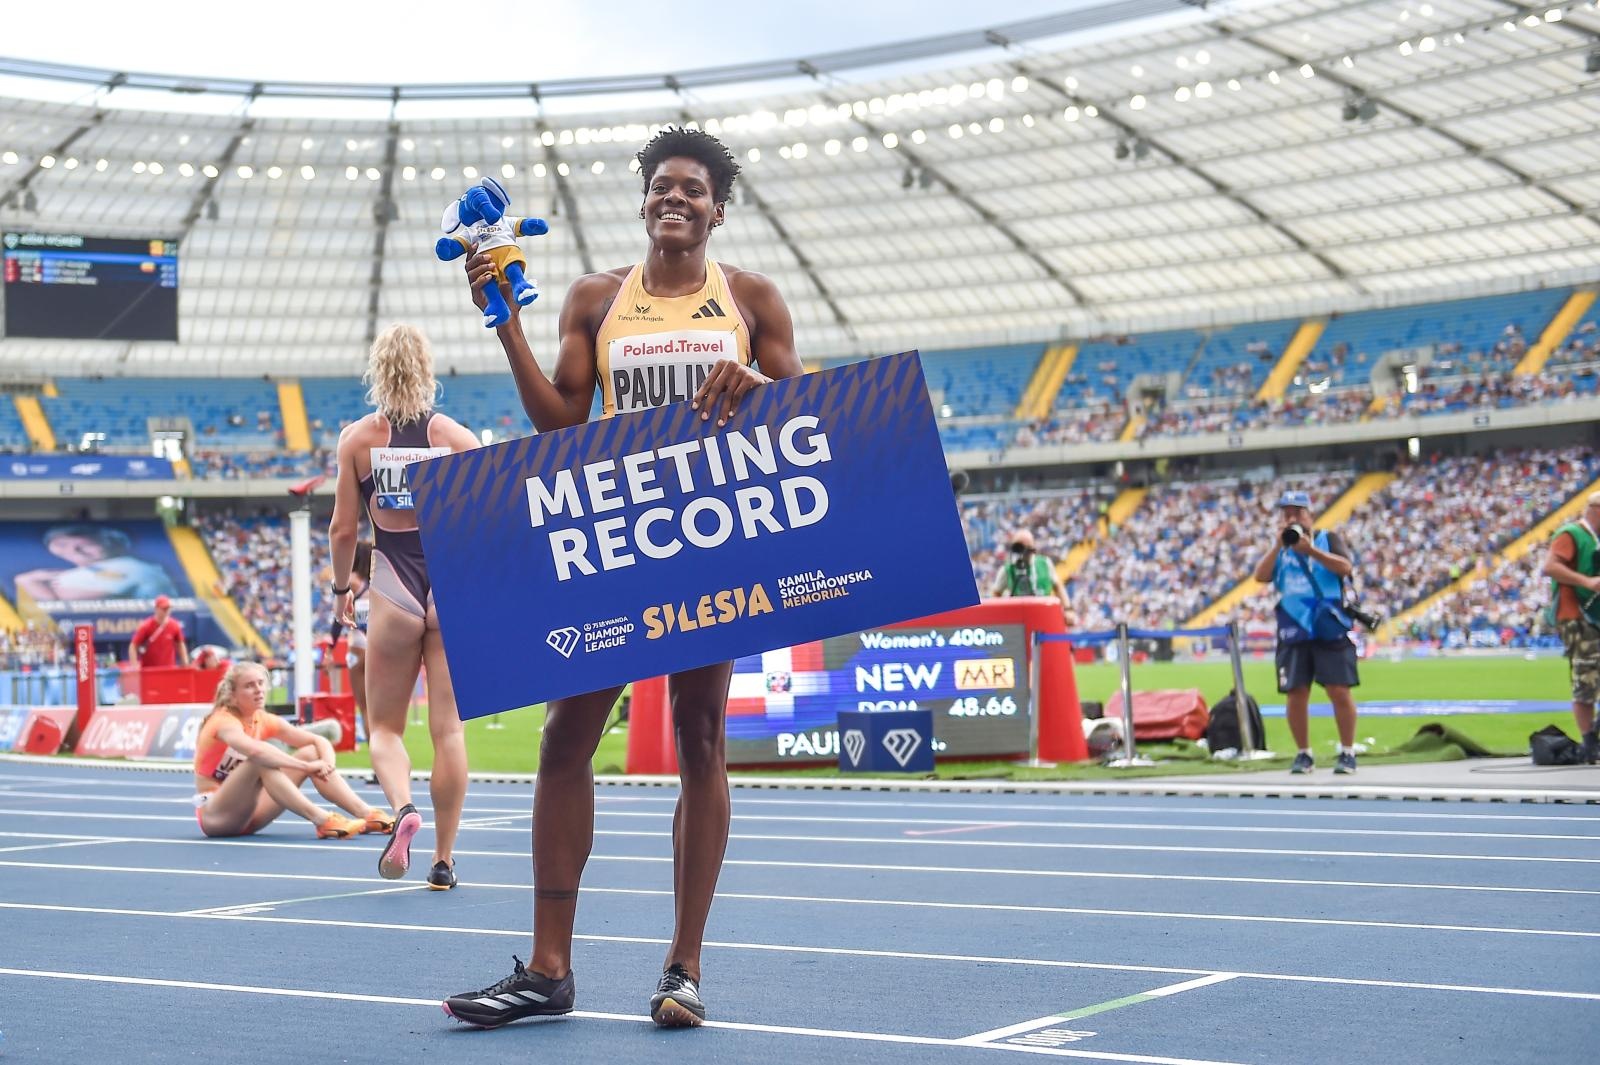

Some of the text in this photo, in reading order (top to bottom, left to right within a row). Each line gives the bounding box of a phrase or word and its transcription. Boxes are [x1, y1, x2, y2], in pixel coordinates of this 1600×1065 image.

[623, 340, 724, 357] Poland.Travel
[613, 364, 713, 410] PAULIN
[374, 468, 411, 493] KLA
[525, 416, 832, 527] MEETING
[548, 475, 829, 581] RECORD
[778, 570, 825, 588] KAMILA
[780, 570, 872, 598] SKOLIMOWSKA
[783, 586, 849, 609] MEMORIAL
[642, 583, 774, 640] SILESIA
[585, 623, 634, 642] DIAMOND
[585, 636, 626, 653] LEAGUE
[860, 628, 1003, 649] Women's 400m
[855, 662, 1007, 692] NEW MR
[948, 696, 1017, 716] 48.66
